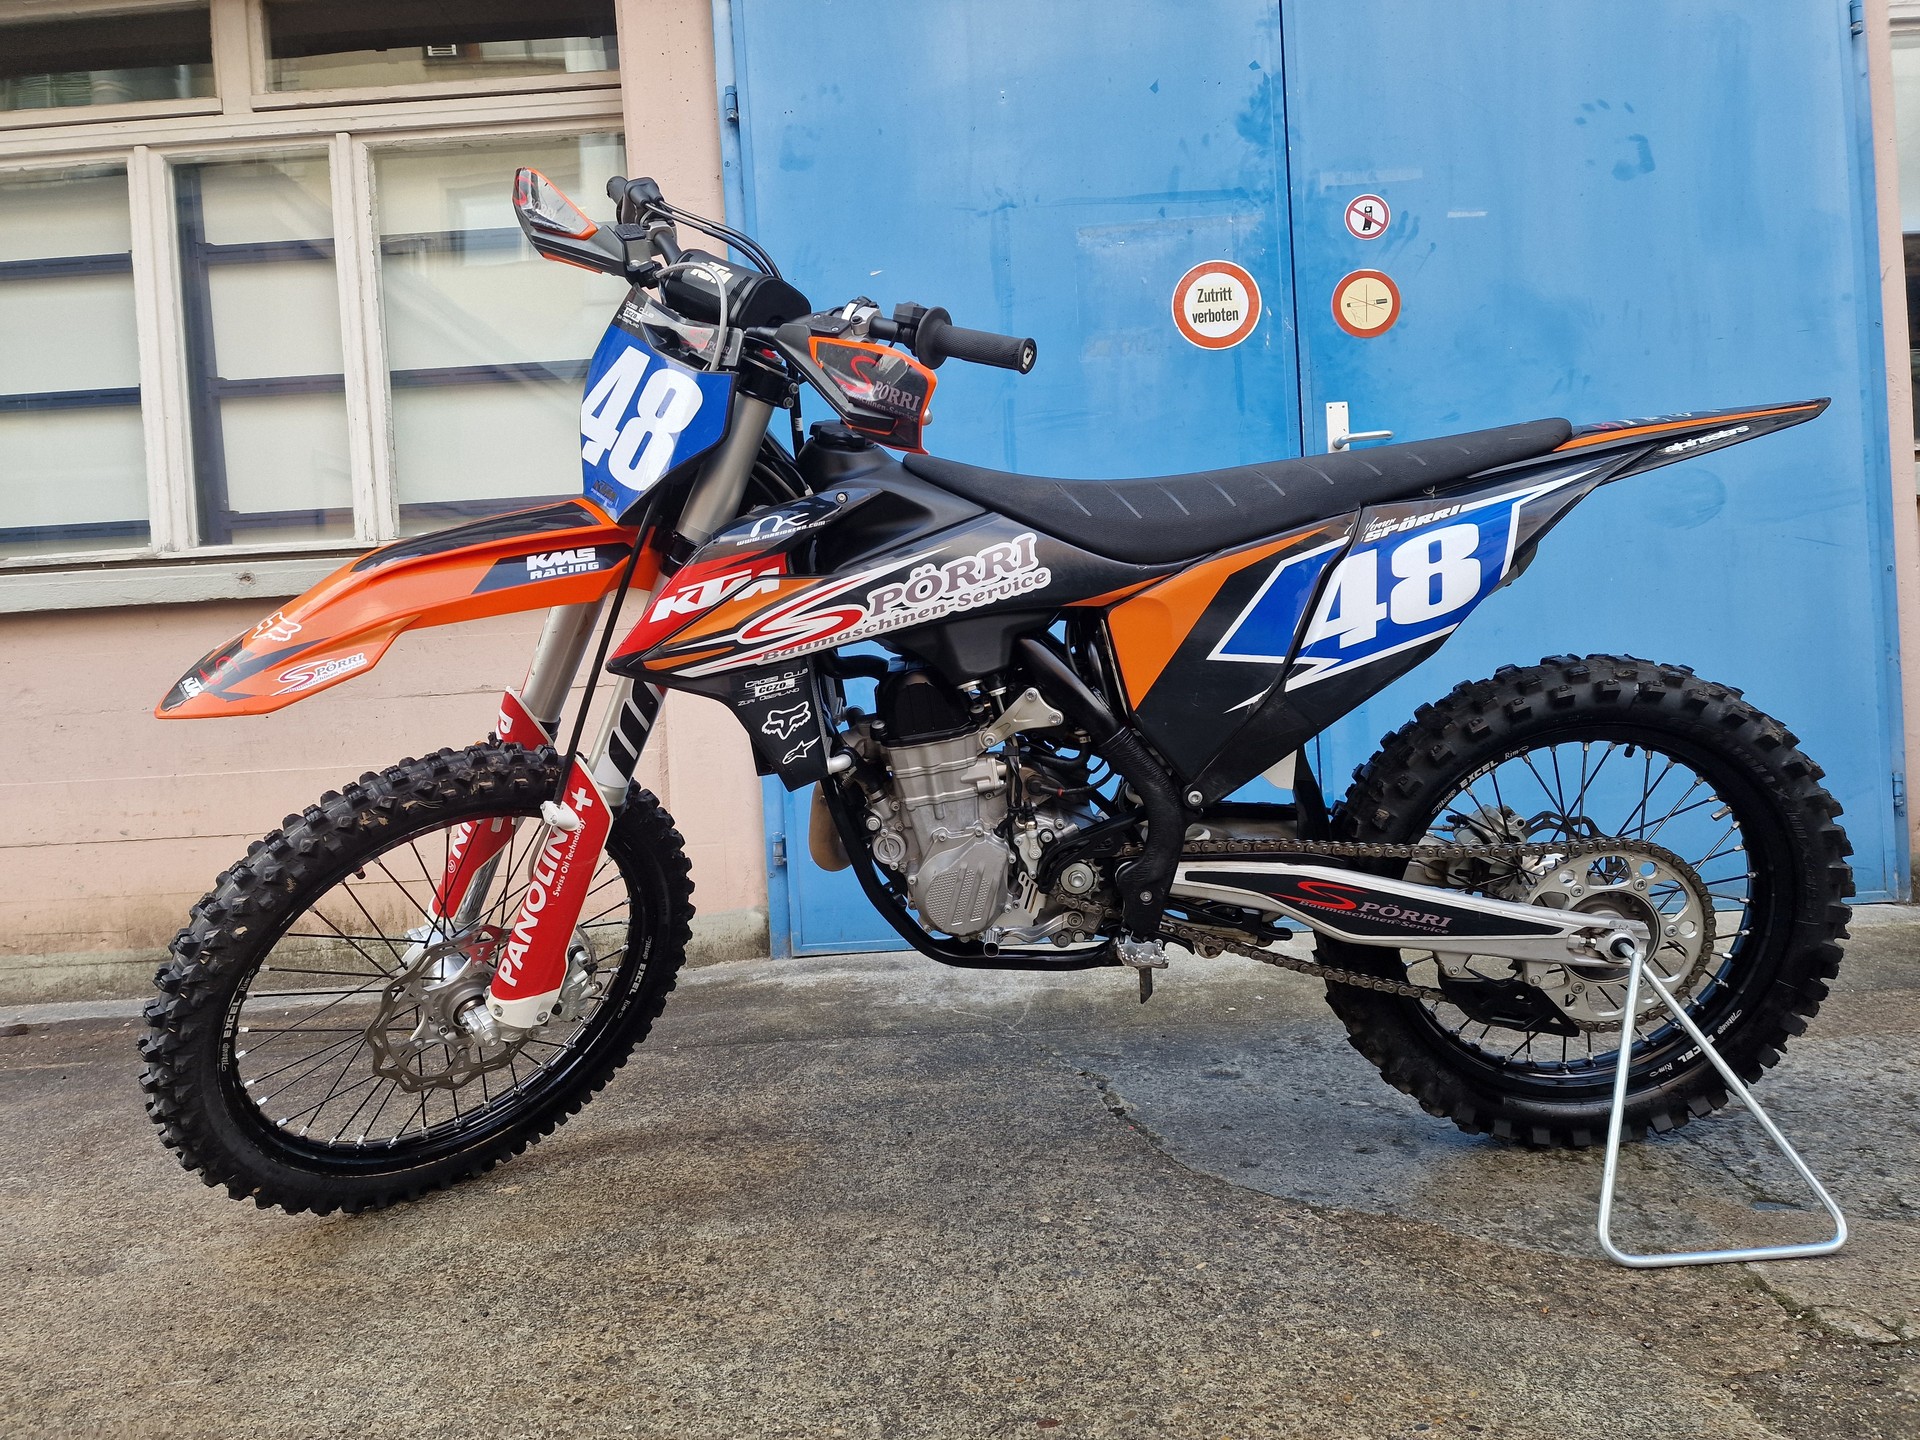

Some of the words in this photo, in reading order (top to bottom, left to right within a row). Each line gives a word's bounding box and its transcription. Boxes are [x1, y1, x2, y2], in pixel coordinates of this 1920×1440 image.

[1197, 287, 1232, 303] Zutritt
[1192, 308, 1239, 324] verboten
[832, 355, 921, 412] SPÖRRI
[580, 345, 703, 491] 48
[1664, 425, 1750, 453] alpinestars
[1361, 504, 1460, 543] SPÖRRI
[526, 547, 597, 571] KMS
[530, 561, 600, 580] RACING
[649, 566, 780, 624] KTM
[712, 534, 1038, 662] SPÖRRI
[1299, 523, 1482, 650] 48
[761, 570, 1048, 663] Baumaschinen-Service
[181, 676, 204, 698] KTM
[276, 654, 364, 693] SPÖRRI
[1459, 760, 1499, 789] EXCEL
[565, 817, 587, 861] Technology
[552, 875, 566, 897] Swiss
[561, 861, 570, 874] Oil
[499, 823, 570, 988] PANOLIN
[1275, 881, 1453, 928] SPÖRRI
[629, 963, 647, 995] EXCEL
[223, 998, 242, 1039] EXCEL
[1677, 1034, 1716, 1063] ECEL
